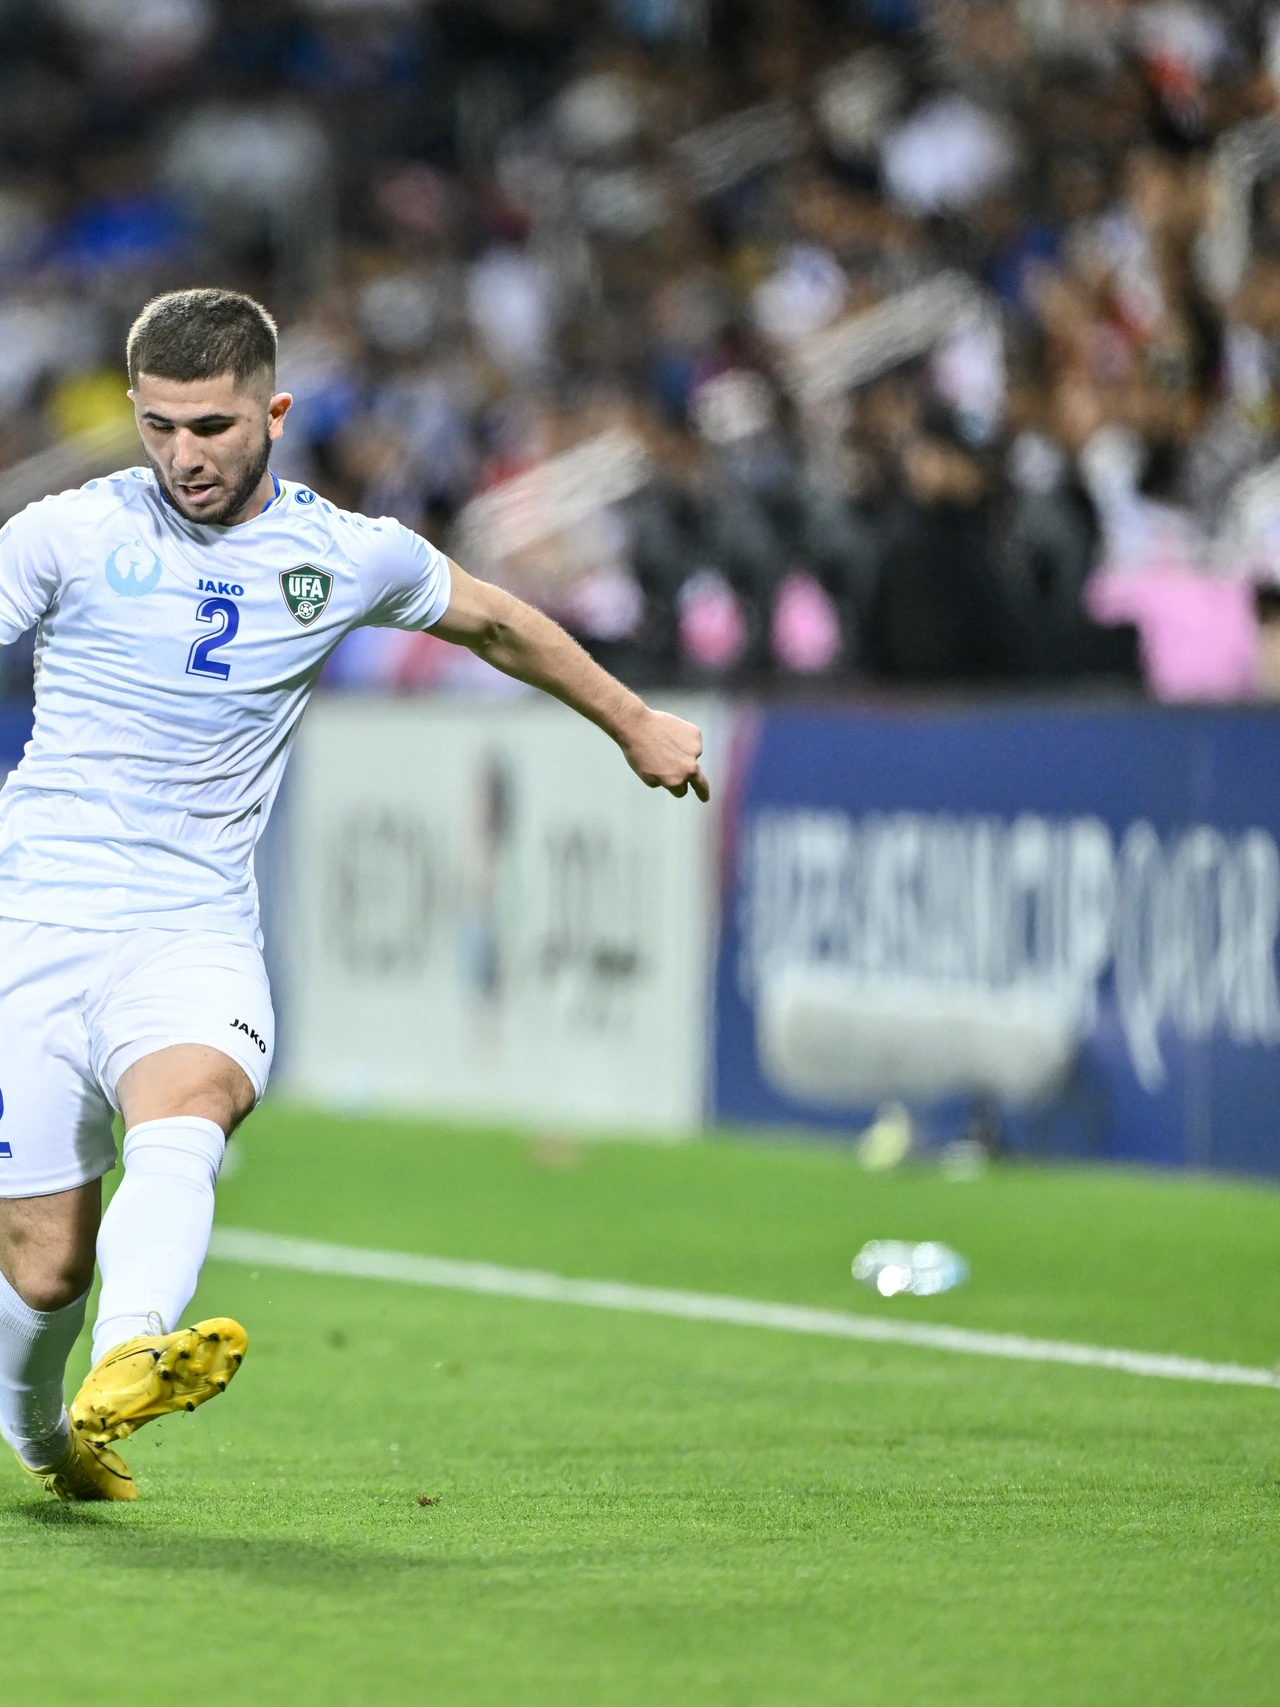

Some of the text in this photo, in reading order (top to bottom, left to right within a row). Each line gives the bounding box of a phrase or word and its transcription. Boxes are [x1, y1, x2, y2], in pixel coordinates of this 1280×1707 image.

[196, 579, 245, 597] JAKO
[288, 577, 324, 598] UFA
[185, 597, 239, 681] 2
[229, 1018, 266, 1054] JAKO
